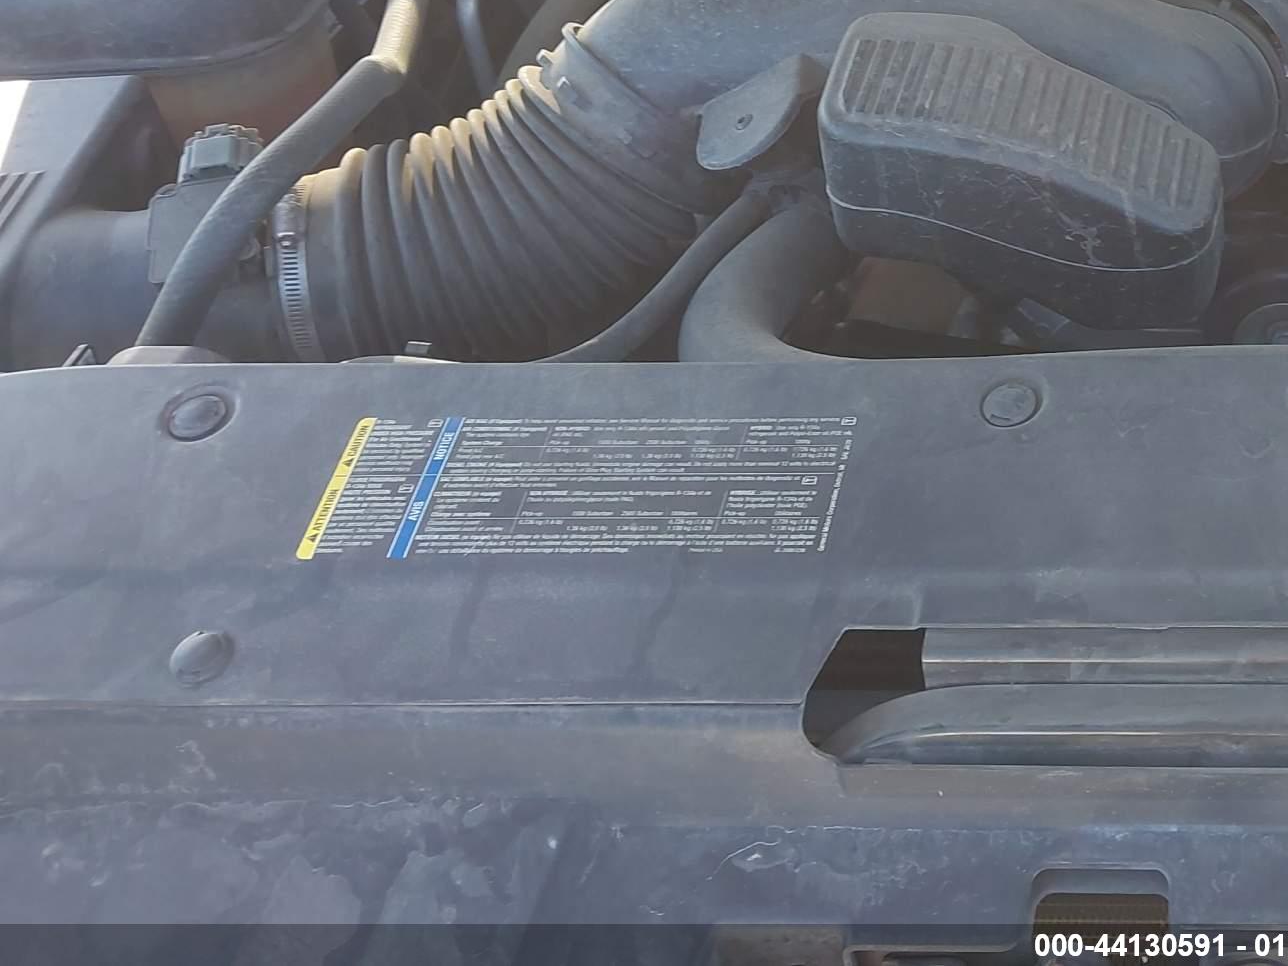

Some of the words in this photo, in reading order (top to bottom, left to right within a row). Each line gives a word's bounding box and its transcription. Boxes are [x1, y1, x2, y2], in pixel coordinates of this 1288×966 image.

[347, 425, 370, 457] CAUTION
[433, 431, 455, 461] NOTICE
[312, 489, 341, 532] ATTENTION
[407, 501, 425, 521] AVIS
